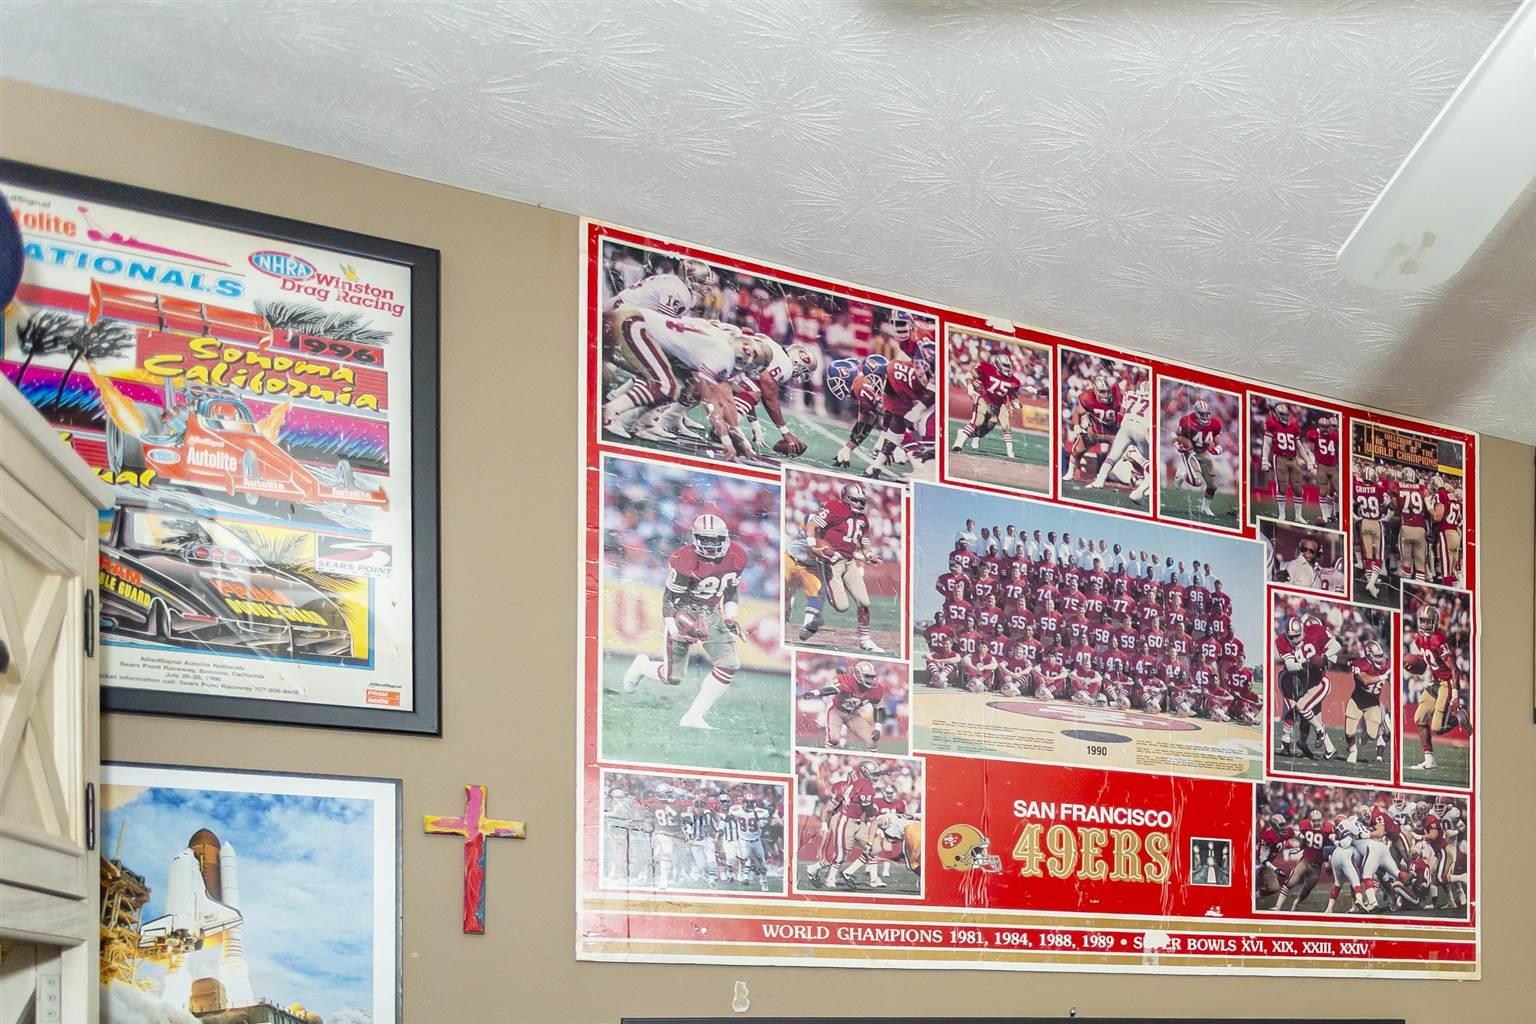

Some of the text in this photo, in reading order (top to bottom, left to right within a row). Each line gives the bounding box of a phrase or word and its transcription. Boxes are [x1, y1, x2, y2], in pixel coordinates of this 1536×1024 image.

[13, 207, 77, 237] tolite
[24, 241, 243, 298] ATIONALS
[258, 256, 395, 301] NHRA Winston
[280, 279, 405, 318] Drag Racing
[188, 338, 356, 386] Sonoma
[284, 336, 376, 363] 1996
[144, 354, 379, 412] California
[1277, 432, 1295, 450] 95
[1318, 439, 1335, 455] 54
[186, 446, 238, 472] Autolite
[1396, 451, 1438, 467] CHAMPIONS
[1356, 496, 1380, 518] 29
[1400, 492, 1423, 514] 79
[118, 579, 151, 609] GUARD
[949, 605, 966, 619] 53
[981, 612, 1056, 631] 54 55 56
[960, 638, 1004, 654] 30 31
[1148, 636, 1162, 648] 60
[1087, 746, 1107, 756] 1990
[1013, 800, 1172, 828] SAN FRANCISCO
[1305, 831, 1323, 849] 99
[1012, 823, 1172, 884] 49ERS
[762, 924, 830, 940] WORLD
[837, 927, 943, 944] CHAMPIONS
[949, 930, 989, 946] 1981,
[994, 931, 1033, 948] 1984,
[1039, 933, 1076, 949] 1988,
[1082, 934, 1115, 950] 1989
[1133, 936, 1181, 951] SER
[1187, 938, 1237, 952] BOWLS
[1241, 938, 1267, 955] XVI,
[1272, 940, 1298, 955] XIX,
[1302, 940, 1335, 956] XXIII,
